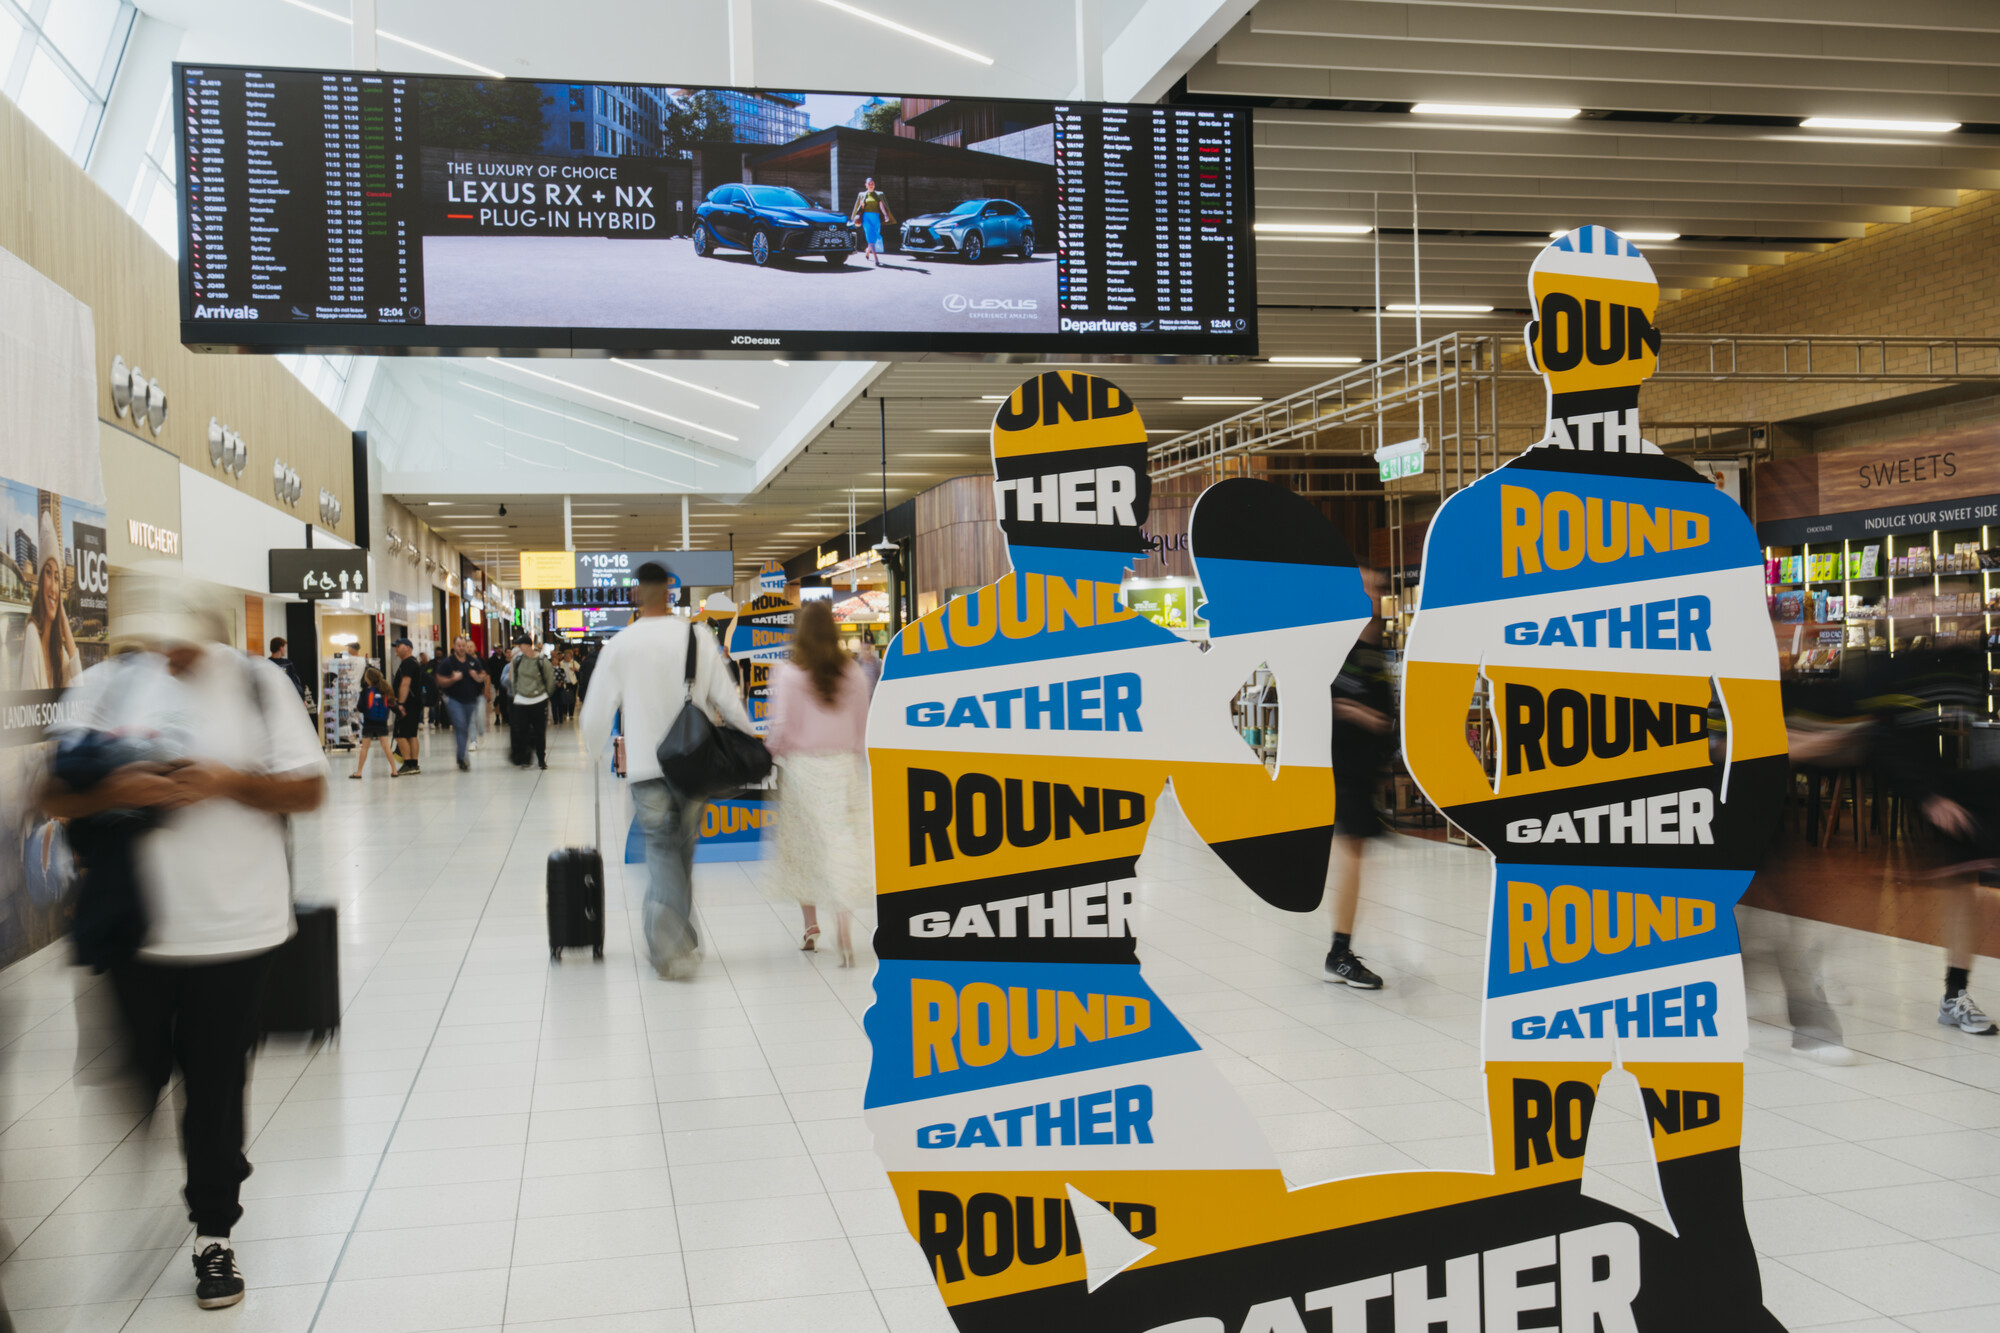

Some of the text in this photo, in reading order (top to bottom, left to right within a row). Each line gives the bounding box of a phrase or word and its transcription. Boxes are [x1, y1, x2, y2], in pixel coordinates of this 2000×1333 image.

[246, 101, 267, 109] Sydney
[246, 110, 267, 118] Sydney
[248, 149, 268, 157] Sydney
[447, 162, 617, 179] THE LUXURY OF CHOICE
[448, 180, 654, 208] LEXUS RX + NX
[480, 208, 656, 230] PLUG-IN HYBRID
[194, 304, 259, 320] Arrivals
[378, 308, 403, 317] 12:04
[969, 299, 1038, 310] LEXUS
[1061, 318, 1138, 334] Departures
[1210, 320, 1231, 328] 12:04
[731, 336, 780, 345] JCDecaux
[1860, 452, 1957, 488] SWEETS
[1501, 484, 1710, 578] ROUND
[1807, 525, 1832, 534] CHOCOLATE
[1865, 505, 1998, 530] INDULGE YOUR SWEET SIDE
[128, 519, 178, 555] WITCHERY
[76, 549, 109, 594] UGG
[592, 554, 629, 568] 10-16
[752, 613, 794, 625] GATHER
[1504, 595, 1711, 652] GATHER
[906, 672, 1143, 732] GATHER
[3, 704, 41, 730] LANDING
[42, 703, 64, 725] SOON
[1505, 683, 1709, 777] ROUND
[696, 804, 779, 839] OUND
[907, 767, 1145, 867] ROUND
[1506, 788, 1714, 845] GATHER
[909, 877, 1137, 938] GATHER
[1508, 881, 1716, 975] ROUND
[1512, 981, 1718, 1040] GATHER
[911, 978, 1151, 1079] ROUND
[917, 1084, 1154, 1149] GATHER
[1513, 1078, 1720, 1171] ROND
